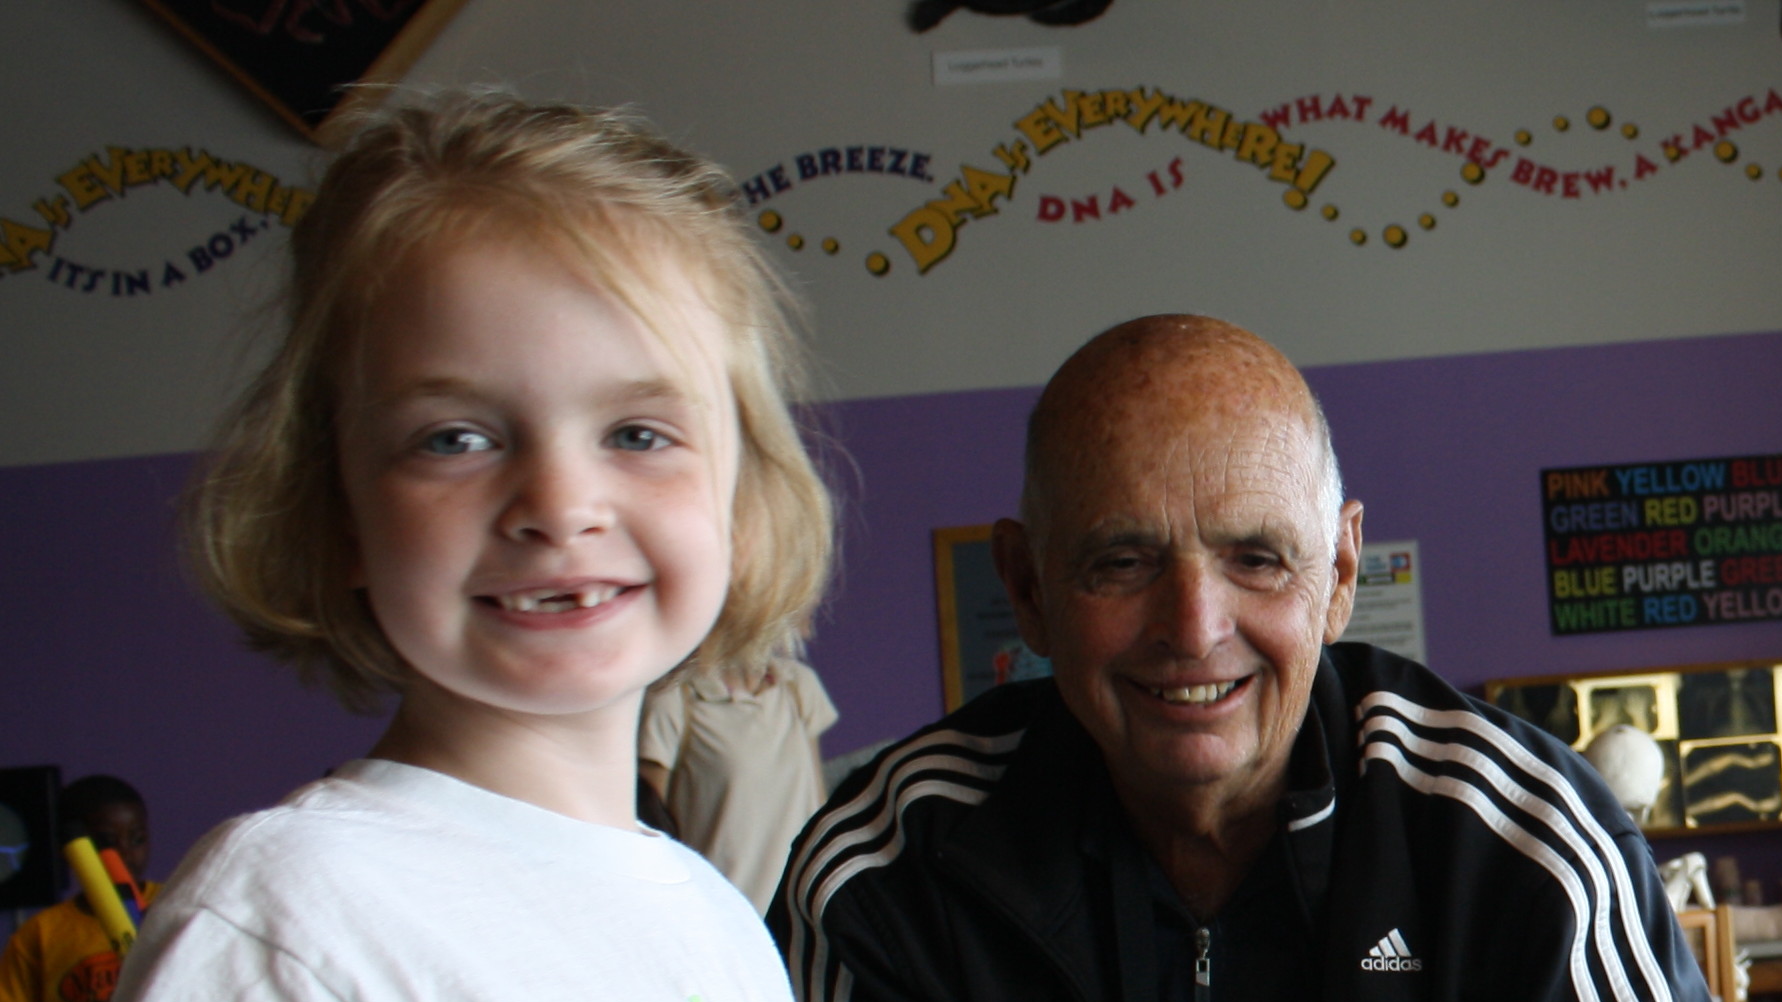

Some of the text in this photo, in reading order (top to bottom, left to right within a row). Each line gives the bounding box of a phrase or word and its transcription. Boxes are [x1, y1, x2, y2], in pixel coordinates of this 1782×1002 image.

[1259, 93, 1373, 129] WHAT
[1377, 105, 1509, 169] MAKES
[1634, 154, 1658, 181] A
[738, 146, 934, 205] HE BREEZE.
[888, 164, 1018, 276] DNA
[1012, 84, 1336, 211] EVERYWHERE!
[1036, 156, 1185, 224] DNA IS
[0, 217, 55, 275] A
[111, 269, 151, 297] IN
[160, 260, 187, 288] A
[1547, 468, 1610, 499] PINK
[1615, 461, 1726, 496] YELLOW
[1551, 501, 1639, 532] GREEN
[1645, 496, 1698, 526] RED
[1551, 529, 1690, 566] LAVENDER
[1554, 567, 1617, 598] BLUE
[1622, 559, 1717, 594] PURPLE
[1554, 597, 1637, 630] WHITE
[1643, 594, 1698, 624] RED
[1360, 956, 1423, 972] adidas
